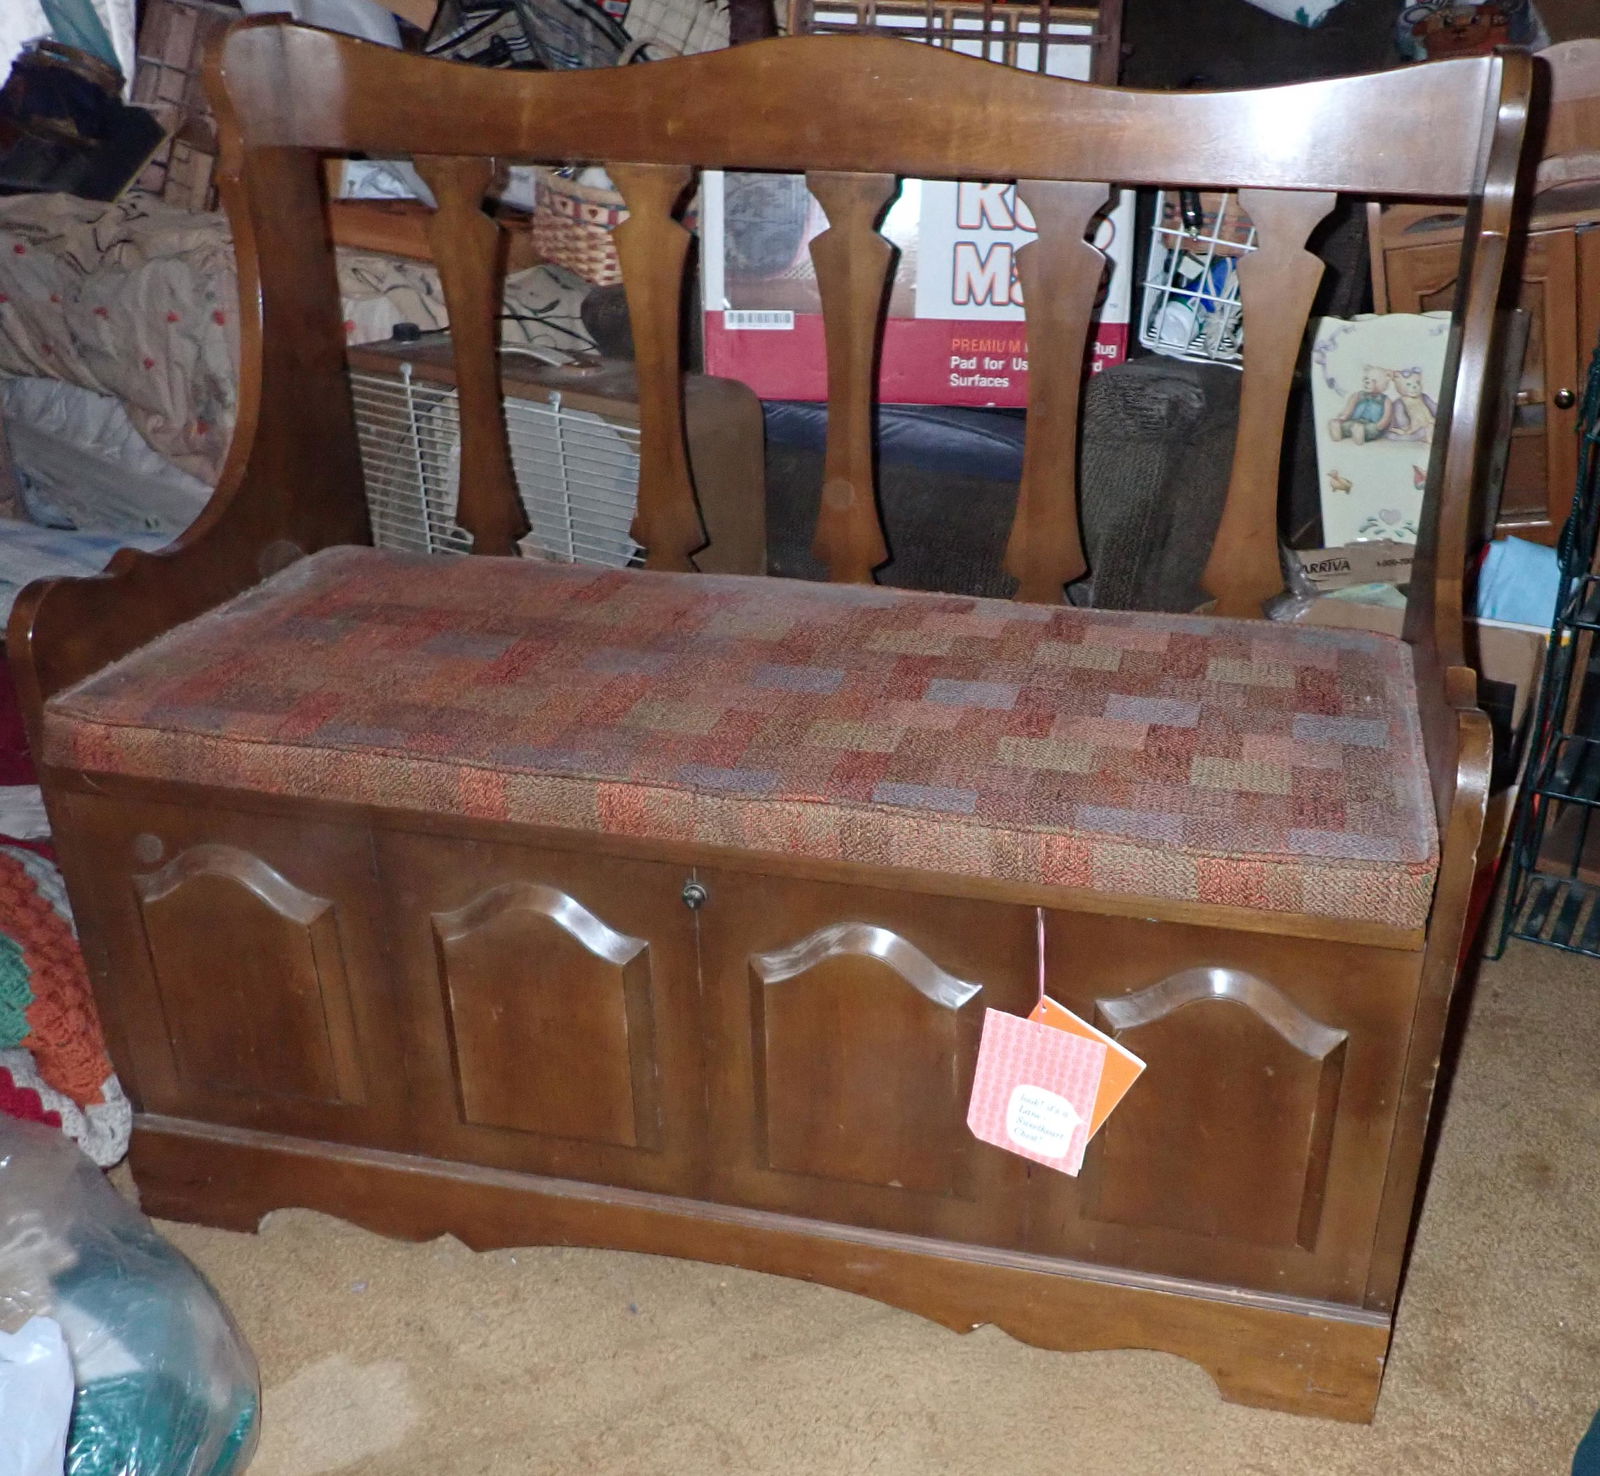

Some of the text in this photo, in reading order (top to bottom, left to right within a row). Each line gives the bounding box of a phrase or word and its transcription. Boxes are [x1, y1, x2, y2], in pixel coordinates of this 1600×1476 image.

[951, 338, 1021, 353] PREMIUM
[950, 356, 1030, 371] Pad for Us
[950, 373, 1010, 388] Surfaces
